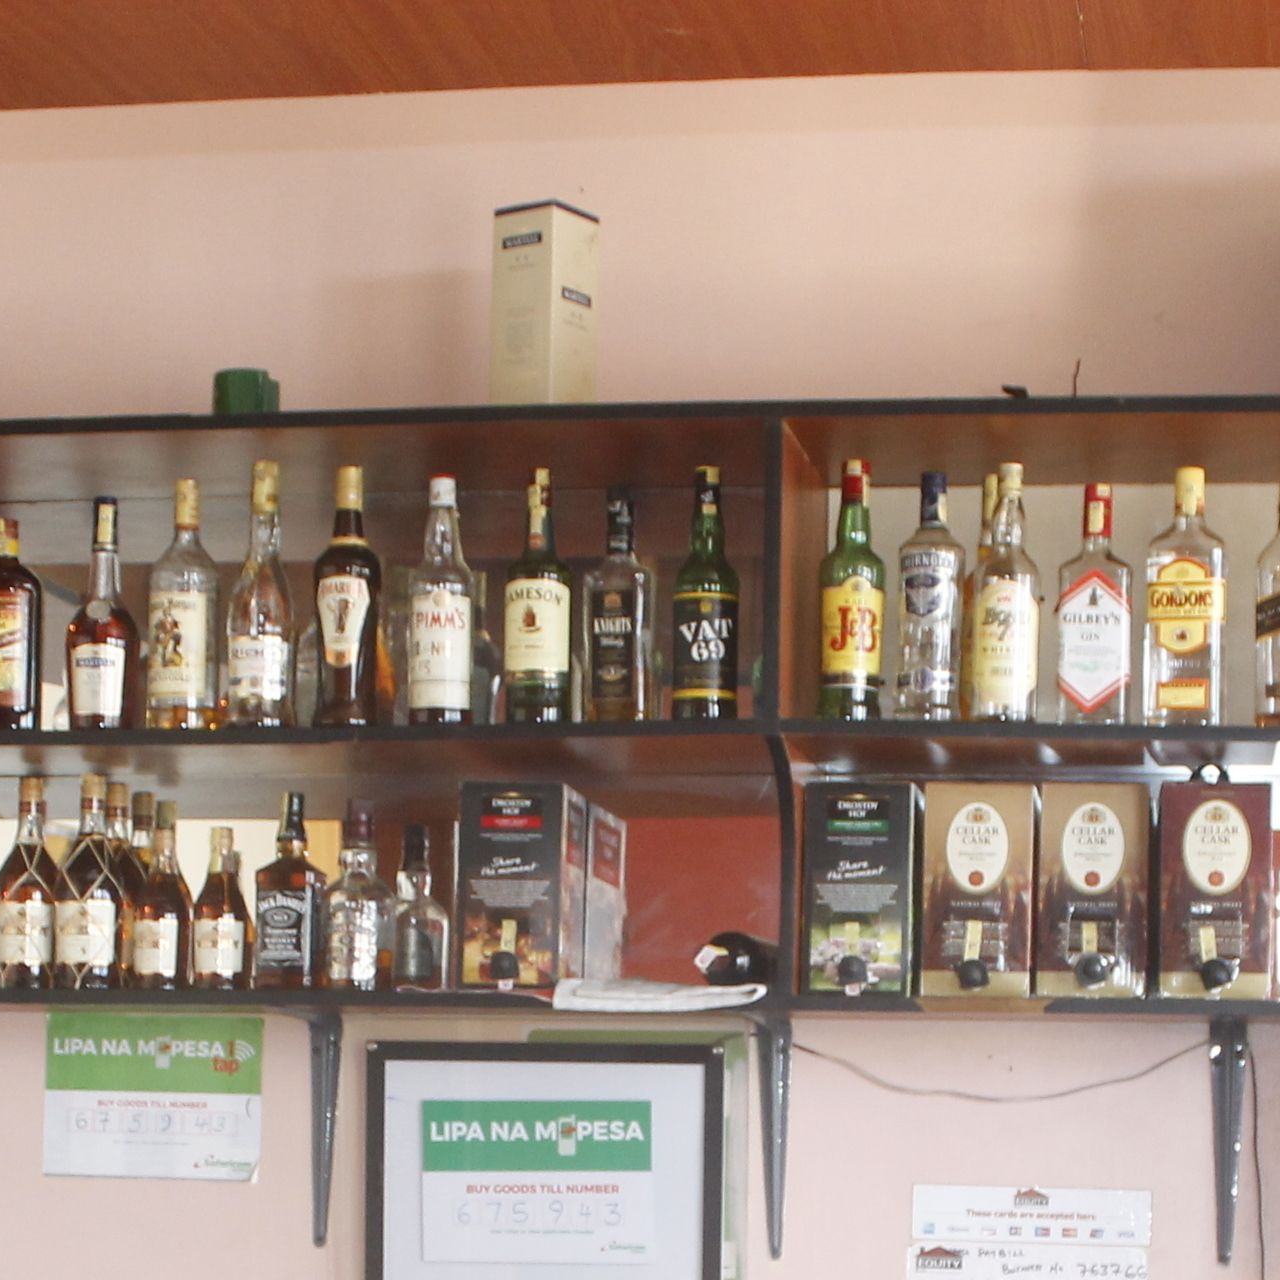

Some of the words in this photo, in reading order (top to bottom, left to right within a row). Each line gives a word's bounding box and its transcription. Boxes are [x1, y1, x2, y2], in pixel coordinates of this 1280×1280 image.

[416, 608, 466, 629] PIMM'S
[1063, 612, 1121, 624] GILBEY'S
[679, 618, 733, 643] VAT
[691, 639, 726, 662] 69
[962, 835, 992, 845] CASK
[1077, 836, 1108, 846] CASK
[1201, 835, 1231, 845] CASK
[838, 860, 869, 873] Share
[53, 1037, 97, 1055] LIPA
[101, 1038, 132, 1056] NA
[430, 1121, 484, 1142] LIPA
[490, 1121, 529, 1142] NA
[466, 1184, 490, 1194] BUY
[493, 1184, 537, 1194] GOODS
[539, 1184, 564, 1194] TILL
[566, 1184, 620, 1195] NUMBER
[966, 1208, 993, 1218] These
[994, 1209, 1019, 1219] cards
[1035, 1211, 1076, 1222] accepted
